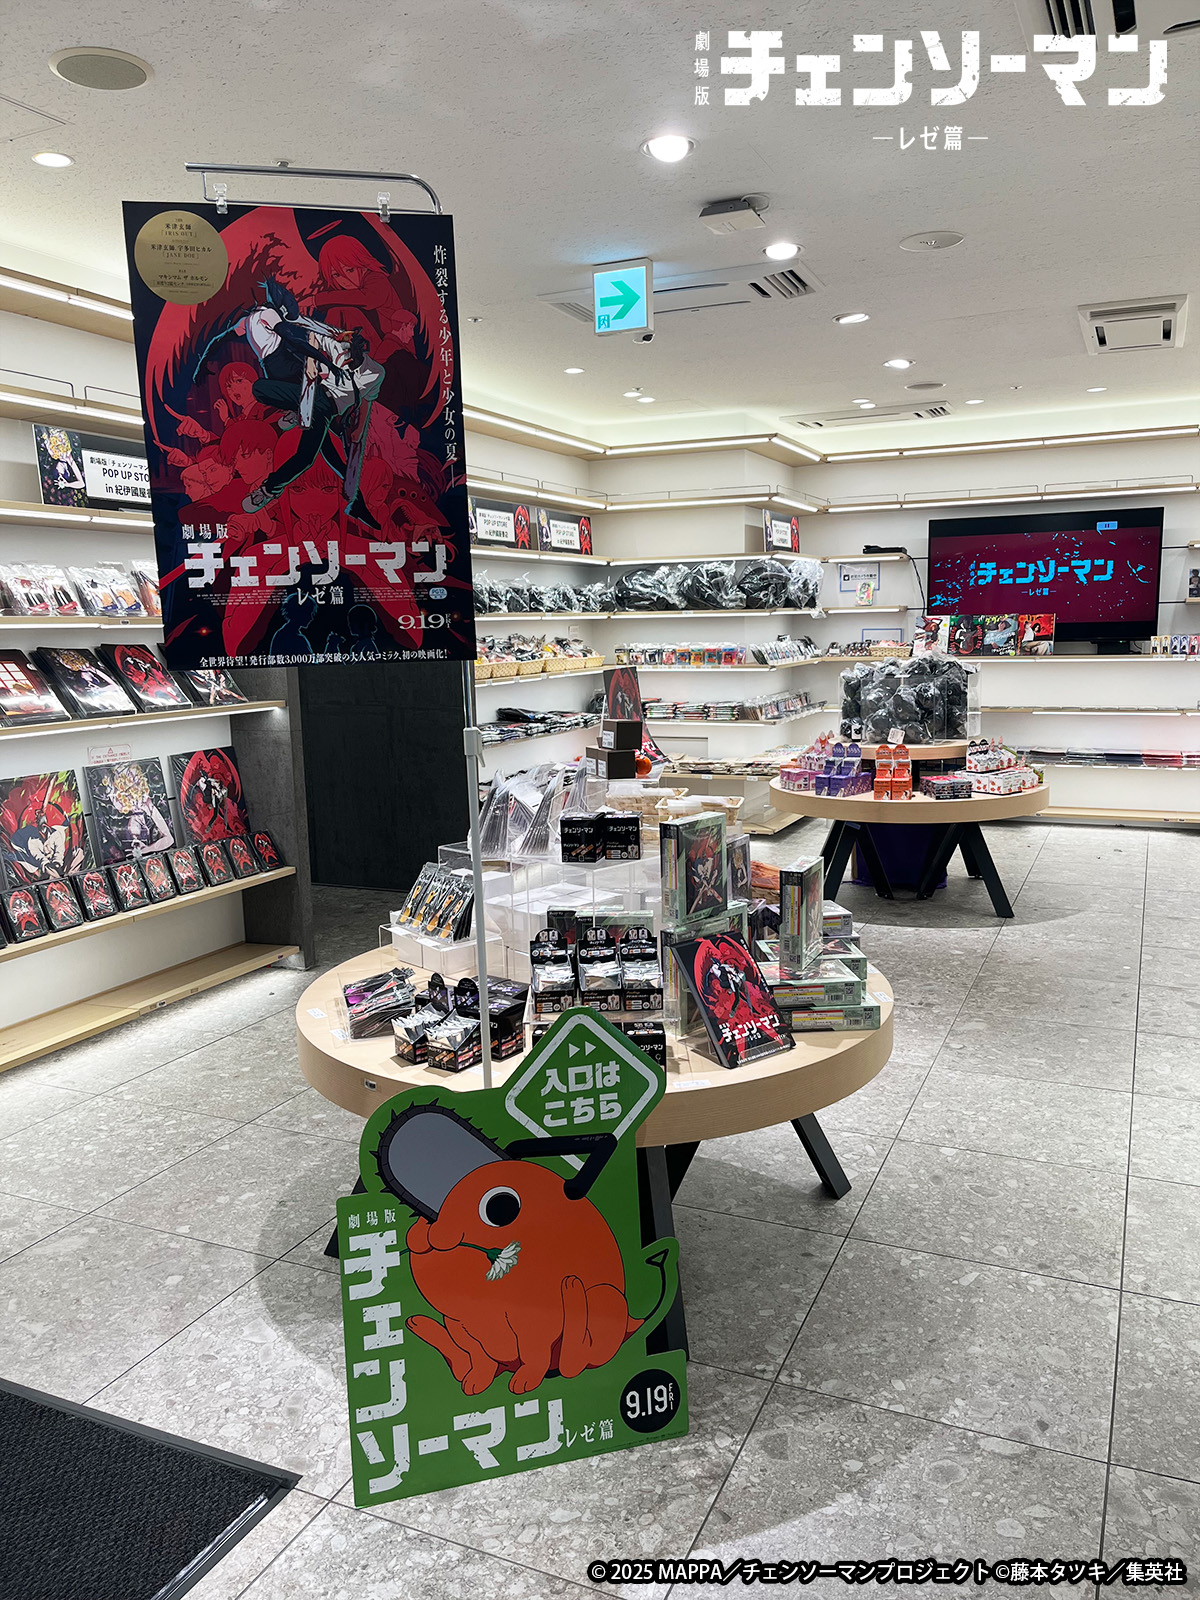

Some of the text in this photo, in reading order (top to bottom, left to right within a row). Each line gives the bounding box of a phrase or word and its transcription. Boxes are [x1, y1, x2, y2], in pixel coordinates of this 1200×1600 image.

[102, 467, 119, 478] POP
[120, 470, 133, 480] UP
[105, 483, 114, 493] in
[181, 523, 229, 540] 劇場版
[184, 540, 448, 588] チェンソーマン
[977, 559, 1114, 585] チェンソーマン
[297, 585, 344, 606] レゼ篇
[398, 613, 445, 631] 9.19
[721, 1014, 781, 1043] チェンソーマン
[639, 1044, 664, 1052] ンソーマン
[541, 1060, 621, 1097] 入口は
[543, 1092, 623, 1128] こちら
[347, 1208, 397, 1230] 劇場版
[625, 1384, 669, 1420] 9.19
[563, 1418, 615, 1449] レゼ篇
